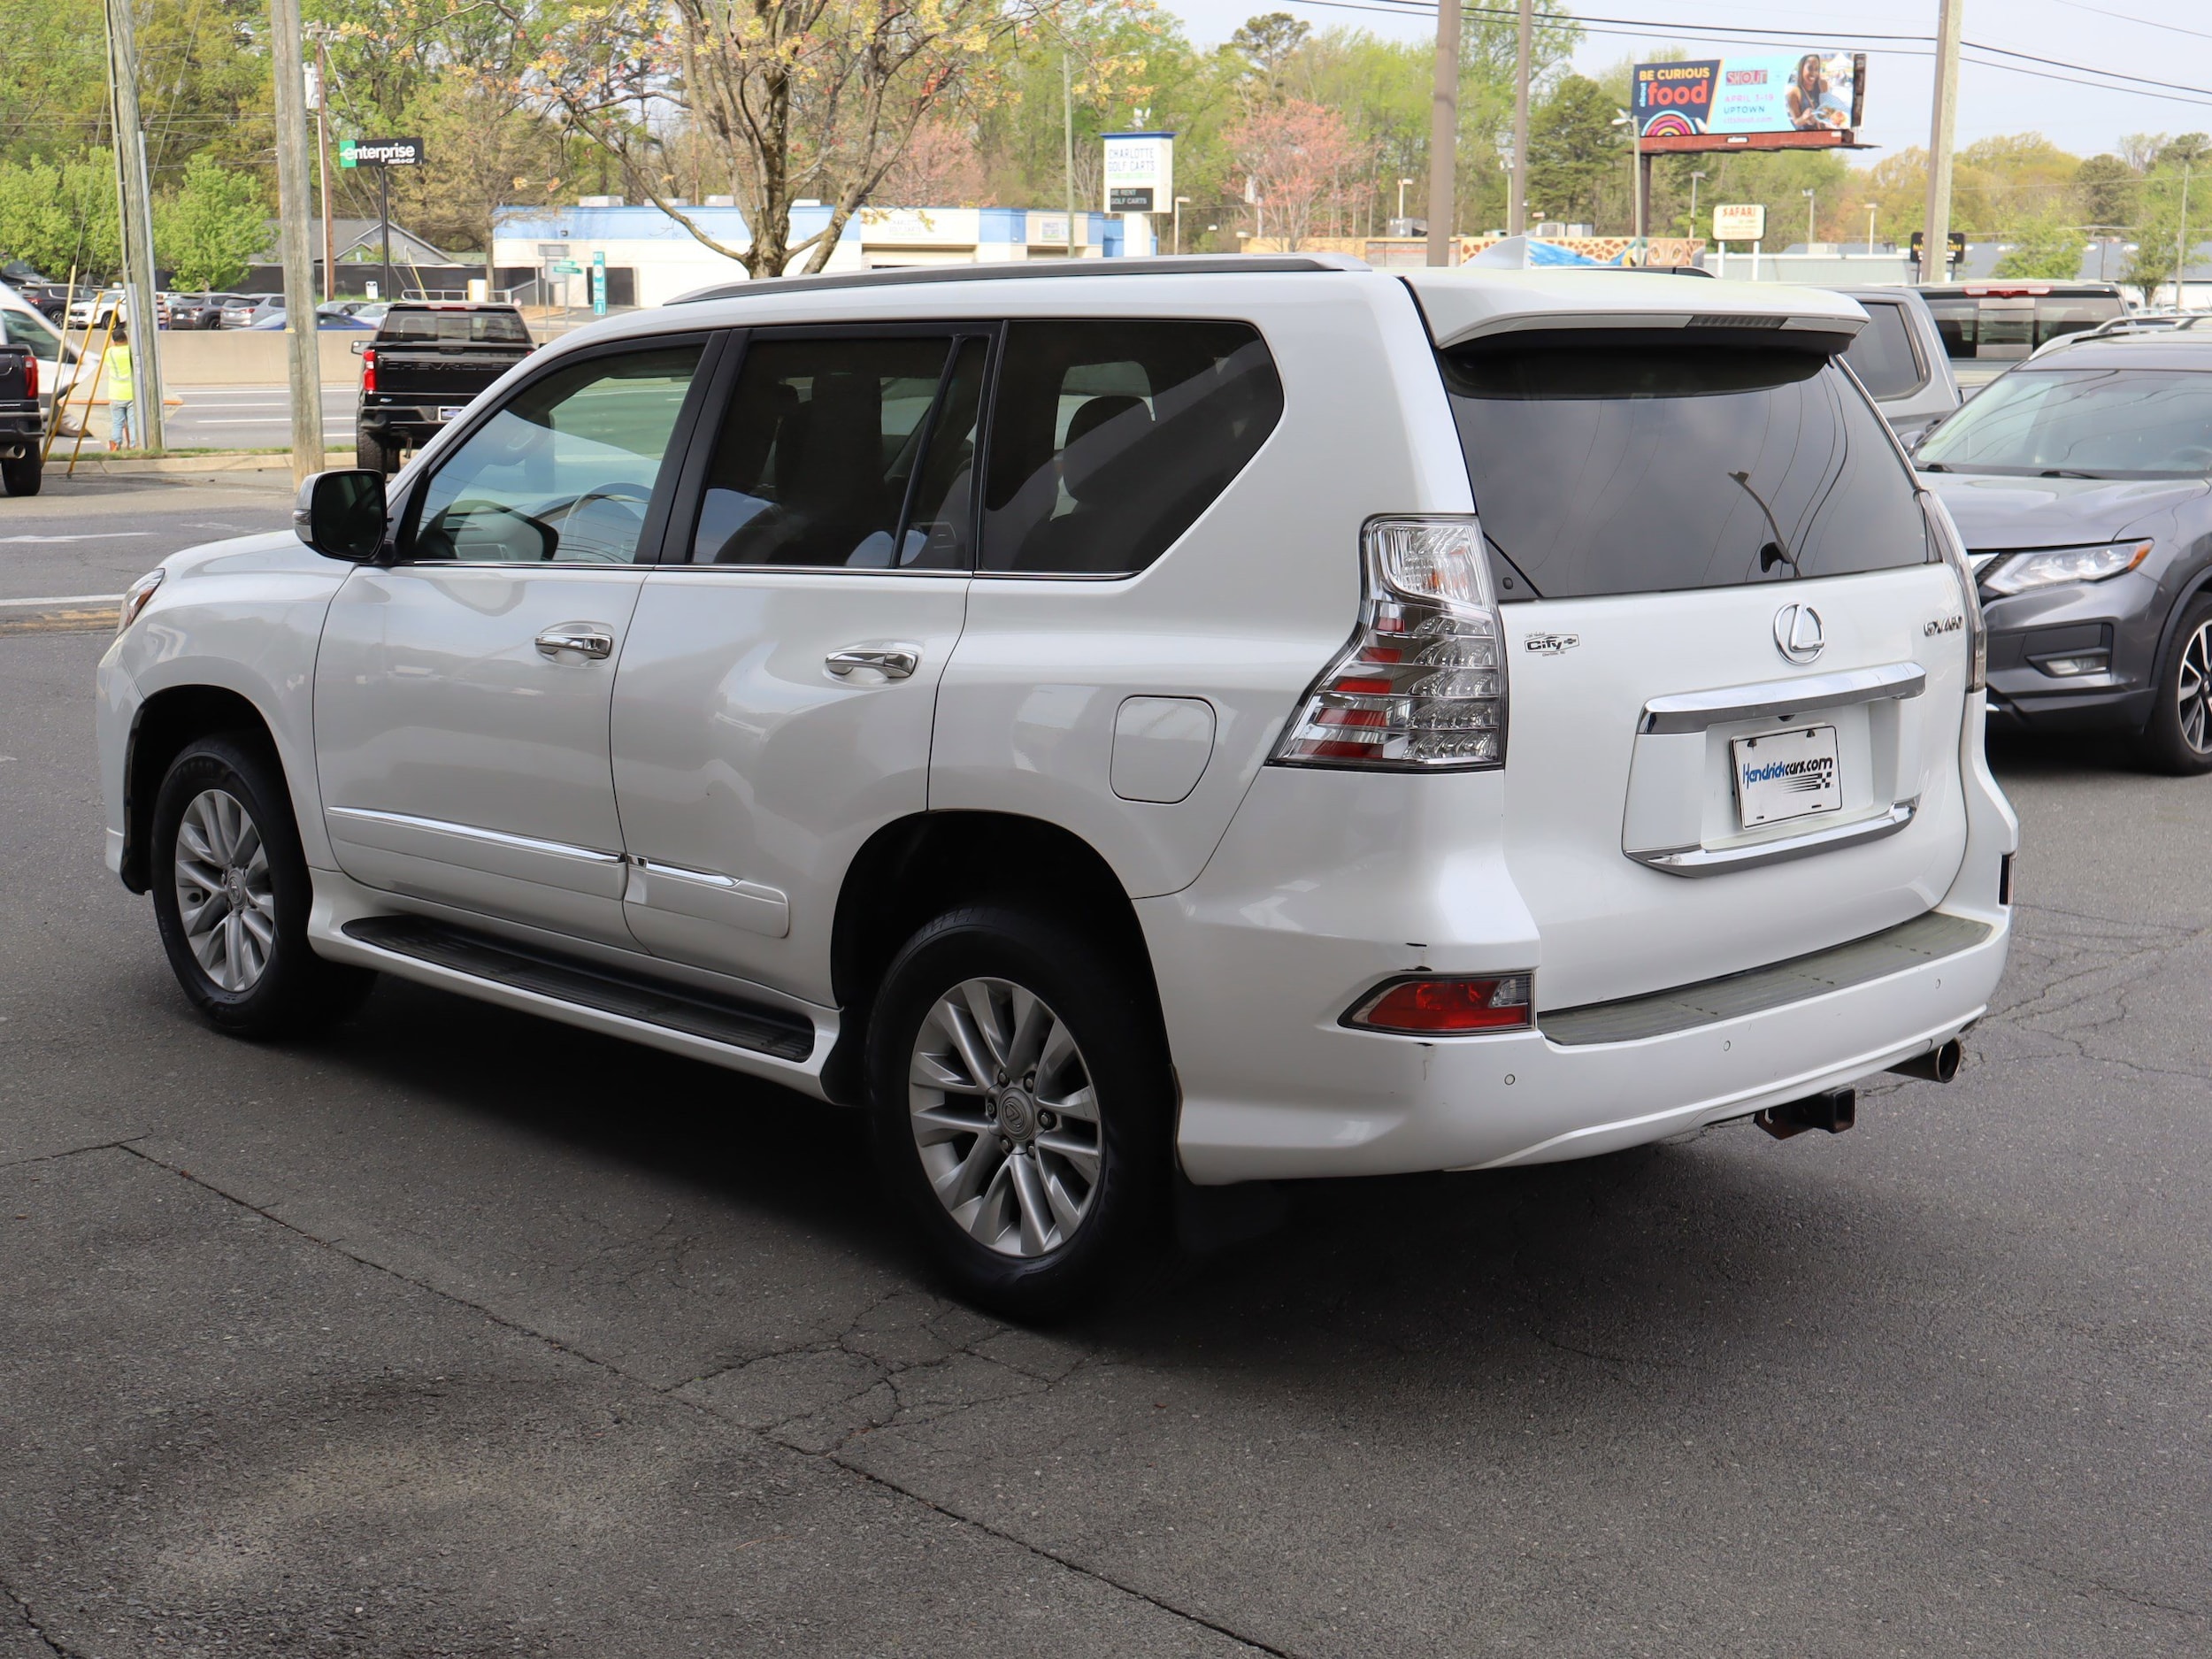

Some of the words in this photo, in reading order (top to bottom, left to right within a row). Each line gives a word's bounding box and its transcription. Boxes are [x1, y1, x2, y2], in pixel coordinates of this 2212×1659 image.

[1639, 70, 1655, 81] BE
[1657, 67, 1710, 81] CURIOUS
[1639, 82, 1647, 107] about
[1647, 80, 1708, 105] food
[1724, 105, 1765, 114] UPTOWN
[340, 142, 415, 163] enterprise
[1108, 148, 1154, 159] CHARLOTTE
[1108, 161, 1126, 172] GOLF
[1130, 160, 1156, 172] CARTS
[1723, 206, 1756, 218] SAFARI
[386, 362, 518, 371] CHEVROLE
[1742, 757, 1833, 790] Hendrickcars.com
